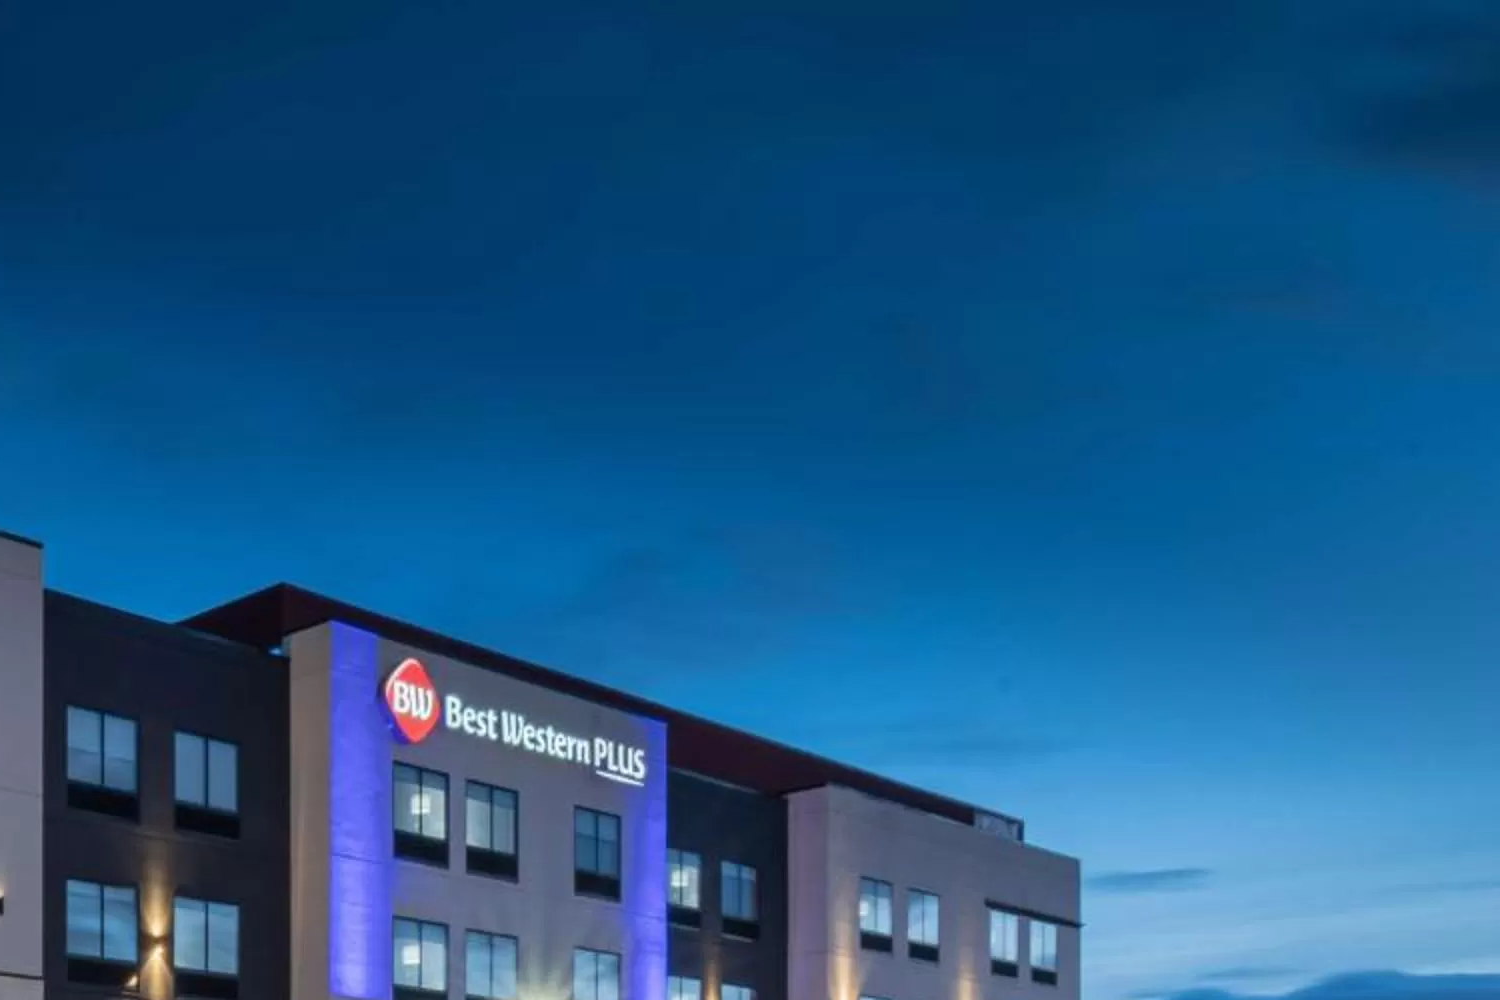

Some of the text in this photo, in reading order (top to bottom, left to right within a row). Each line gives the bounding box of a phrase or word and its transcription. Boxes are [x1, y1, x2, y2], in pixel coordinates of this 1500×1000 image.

[393, 681, 432, 720] BW
[445, 695, 645, 779] Best Western PLUS
